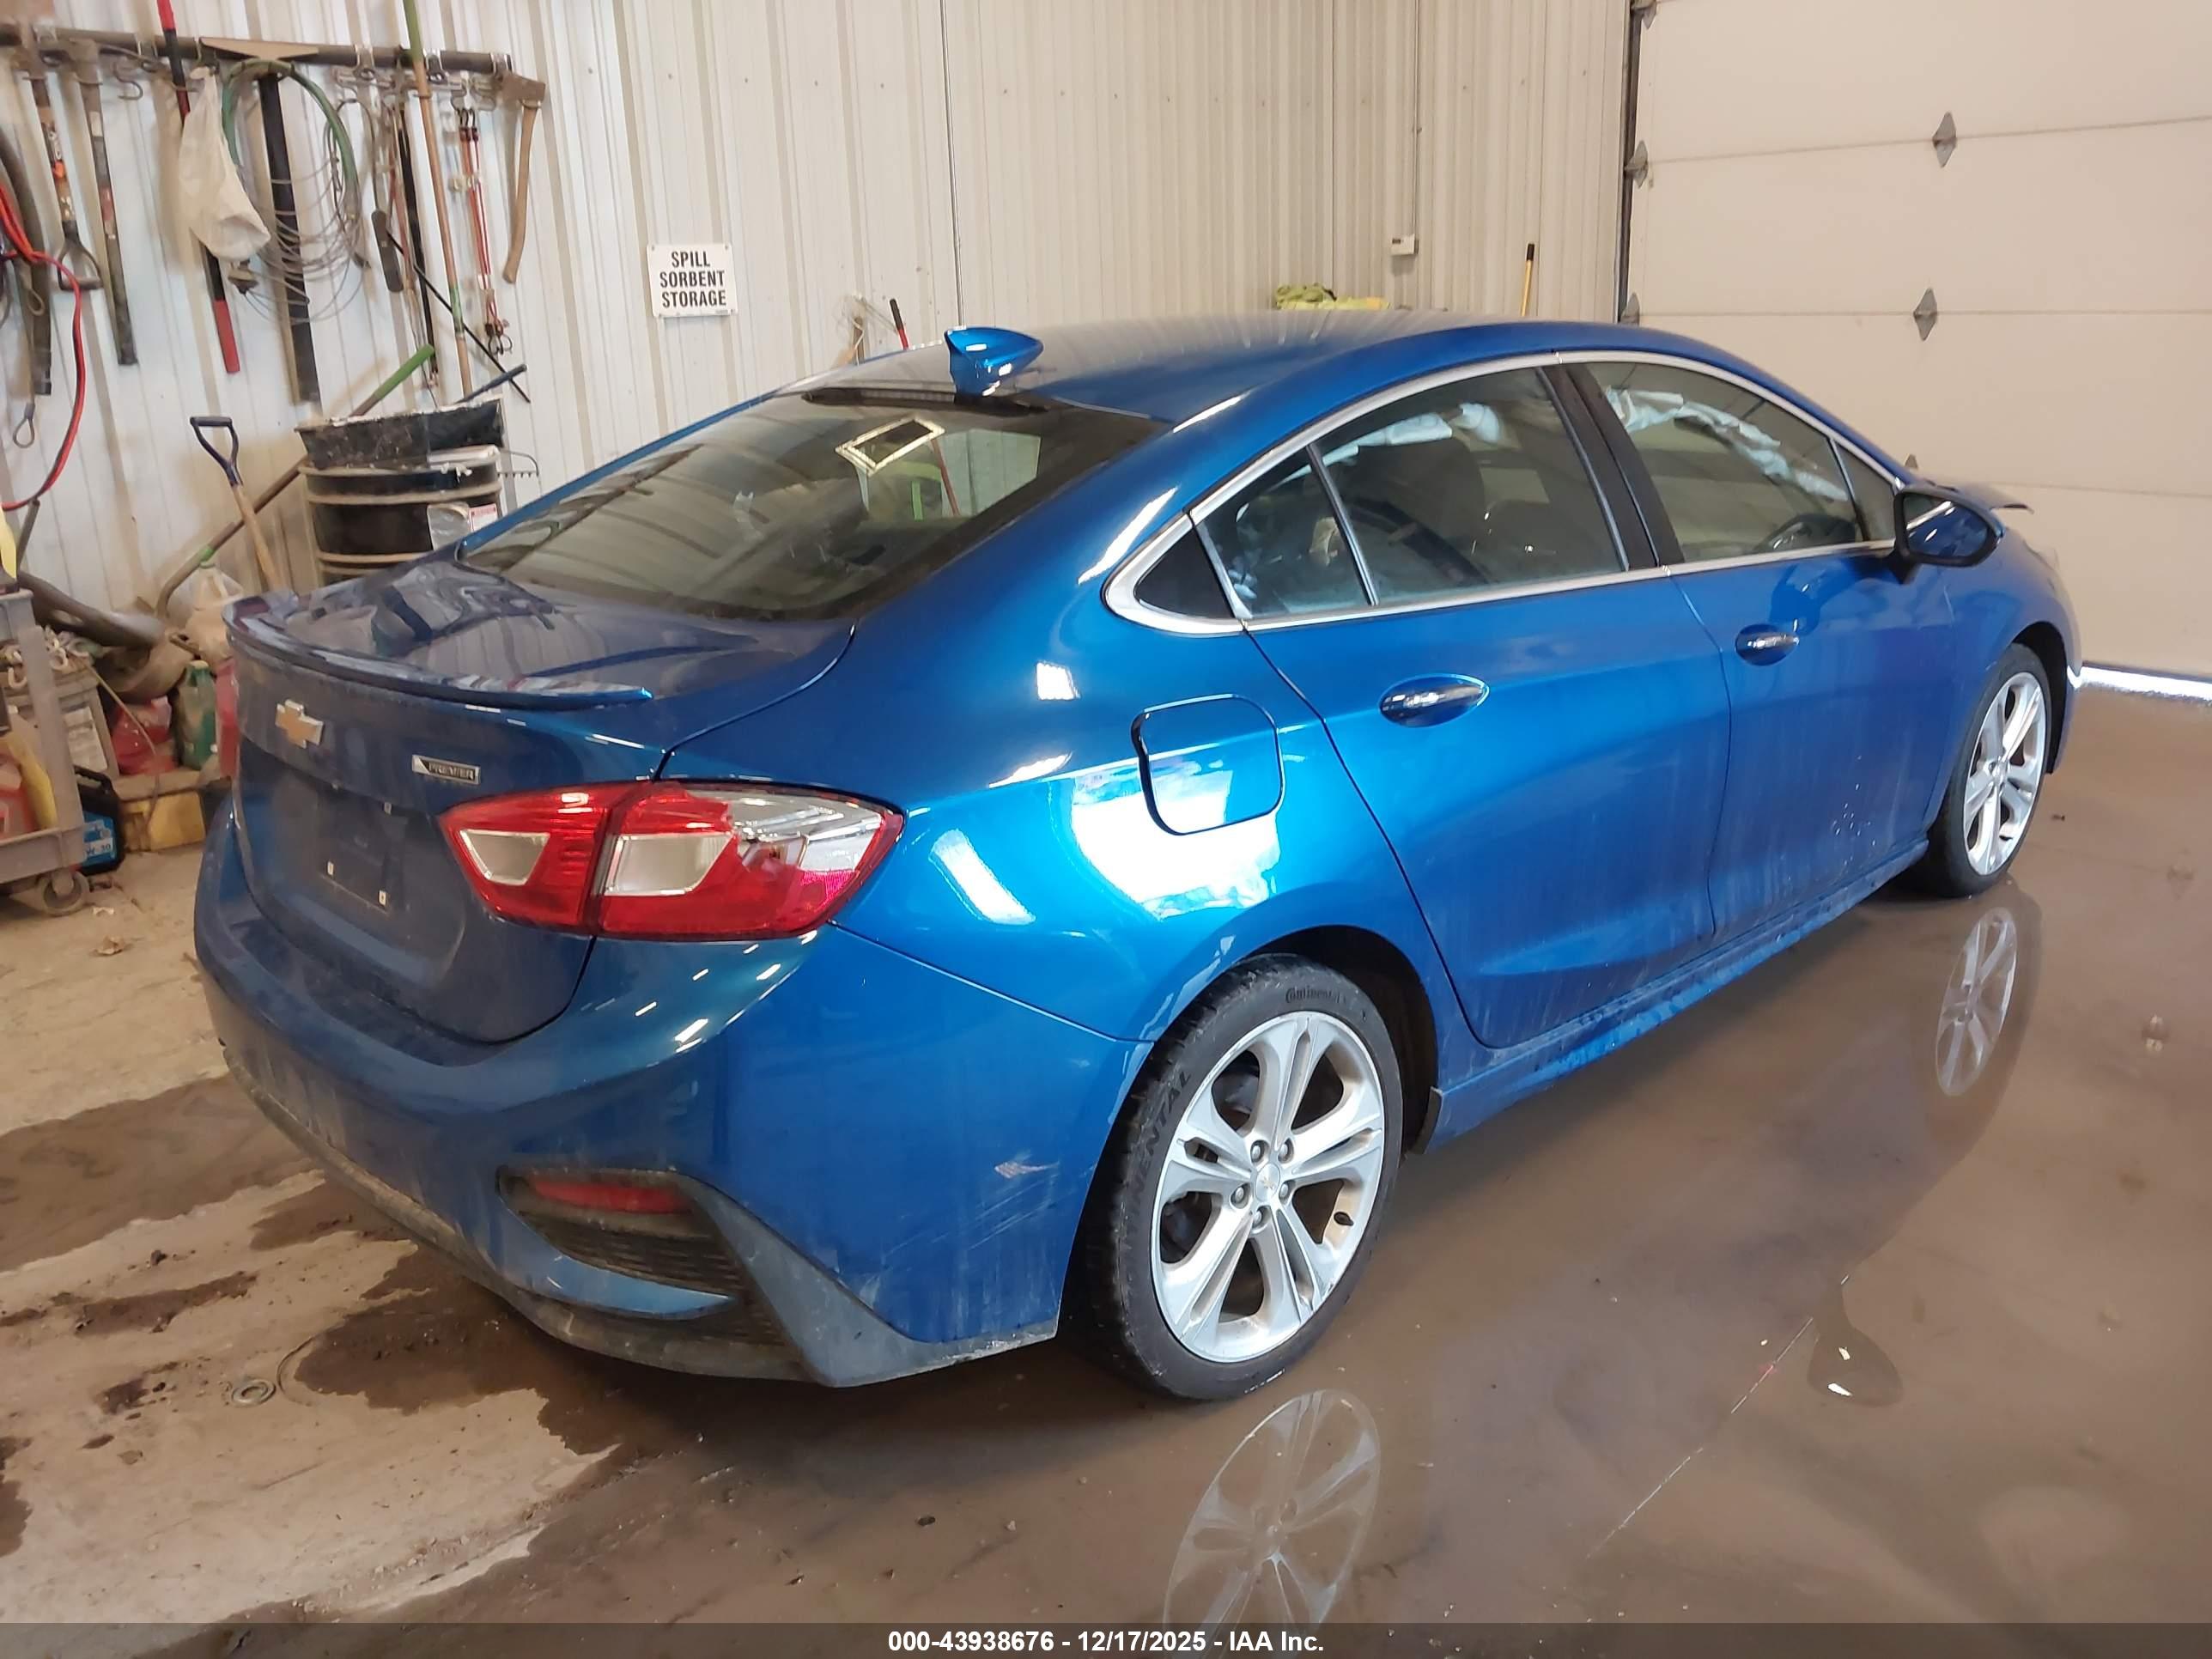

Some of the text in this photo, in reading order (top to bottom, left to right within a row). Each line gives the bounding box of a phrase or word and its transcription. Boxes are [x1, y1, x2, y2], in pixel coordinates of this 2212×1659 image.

[671, 250, 711, 269] SPILL
[659, 270, 725, 288] SORBENT
[661, 290, 726, 308] STORAGE
